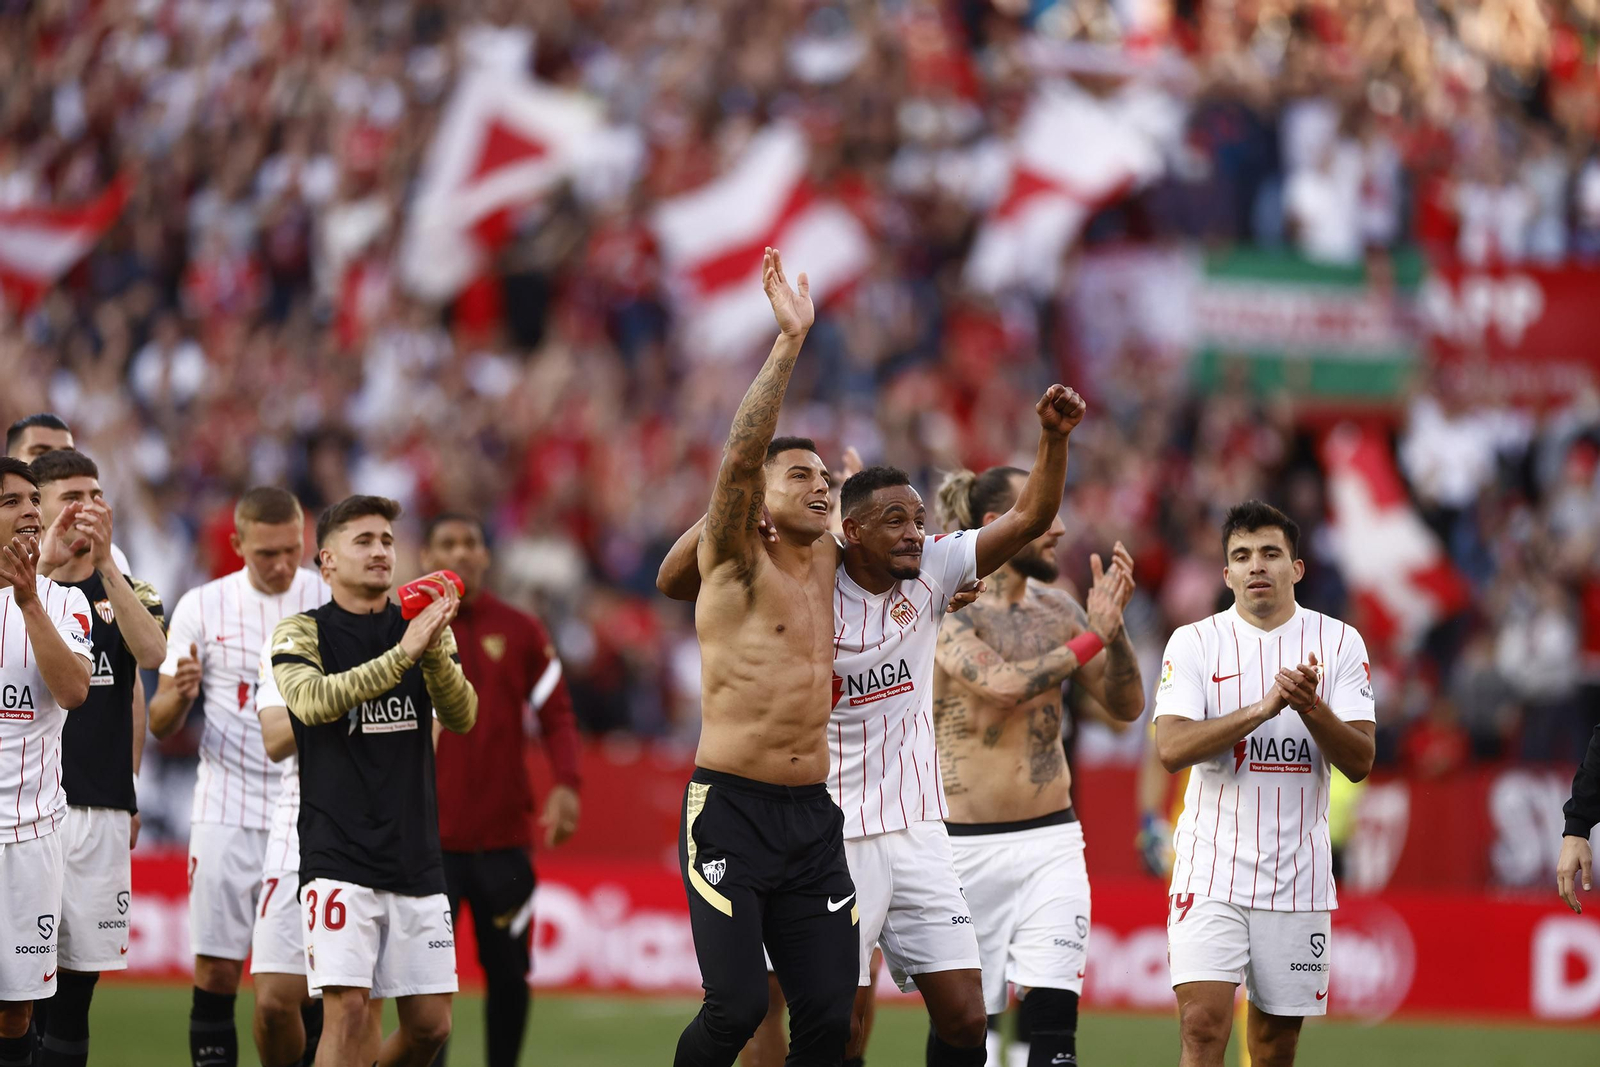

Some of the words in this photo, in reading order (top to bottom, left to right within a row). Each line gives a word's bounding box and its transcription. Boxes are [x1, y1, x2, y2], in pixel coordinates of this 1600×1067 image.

[846, 658, 912, 696] NAGA
[362, 695, 418, 723] NAGA
[865, 691, 887, 702] Investing
[887, 688, 901, 697] Super
[1250, 736, 1311, 762] NAGA
[306, 888, 346, 932] 36
